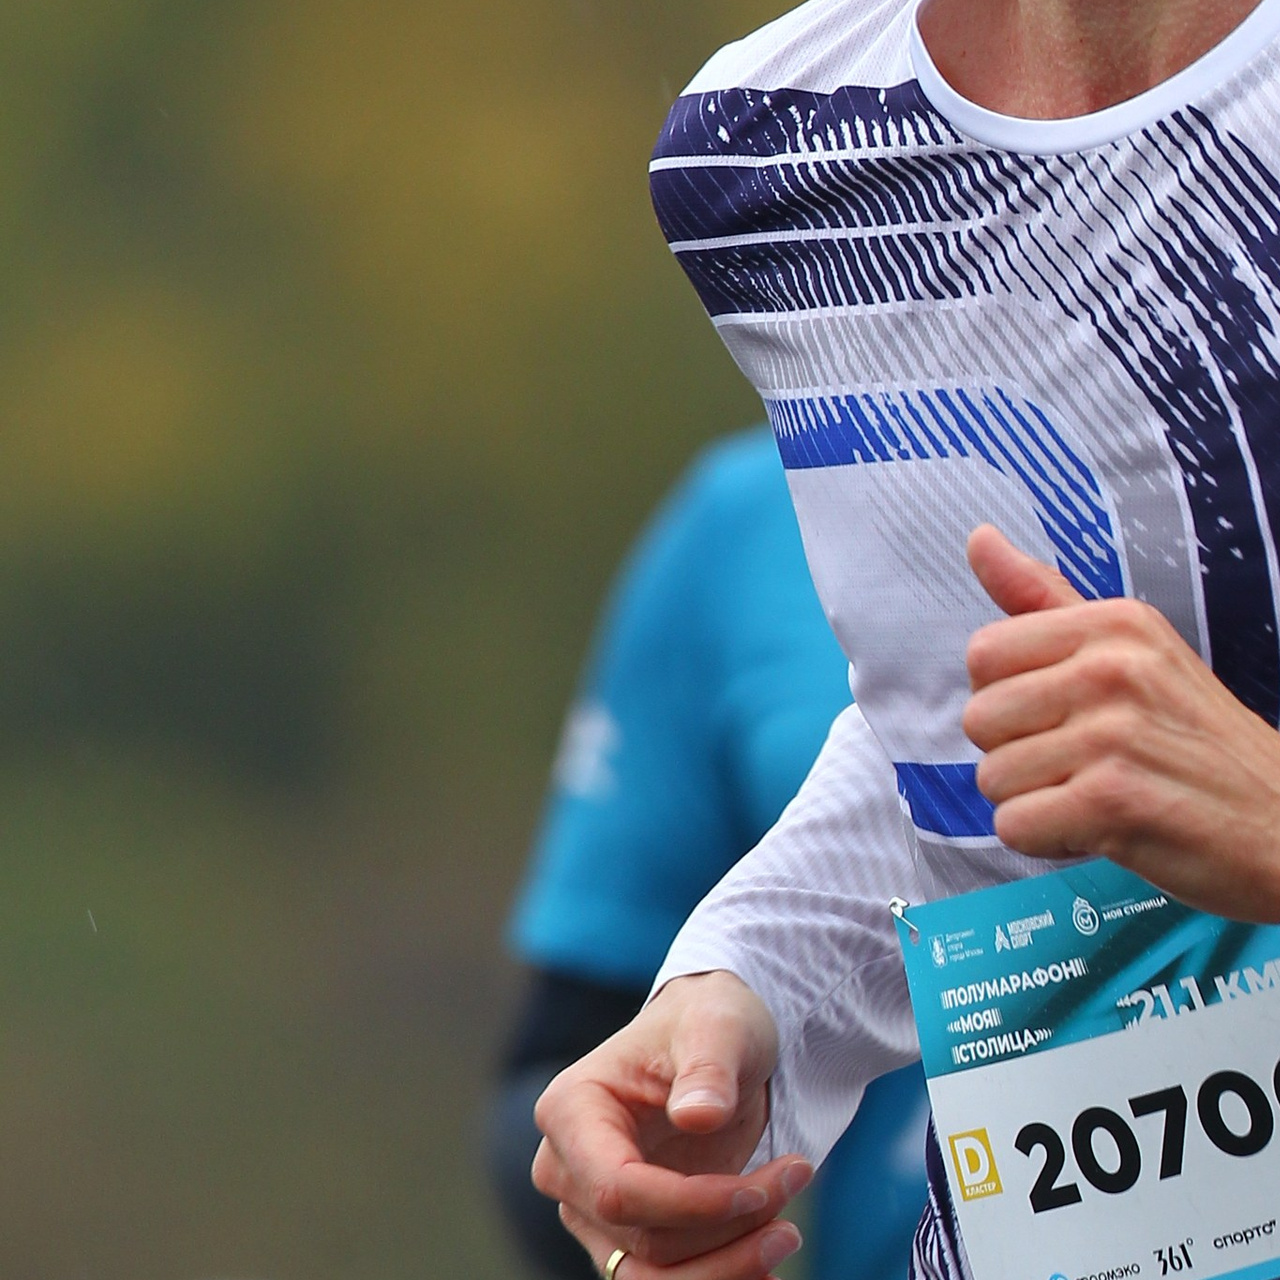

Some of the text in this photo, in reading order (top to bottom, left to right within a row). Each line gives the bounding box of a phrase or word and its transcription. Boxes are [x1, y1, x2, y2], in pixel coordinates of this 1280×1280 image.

[1123, 896, 1168, 916] СТОЛИЦА
[942, 957, 1089, 1010] ПОЛУМАРАФОН
[954, 1136, 990, 1187] D
